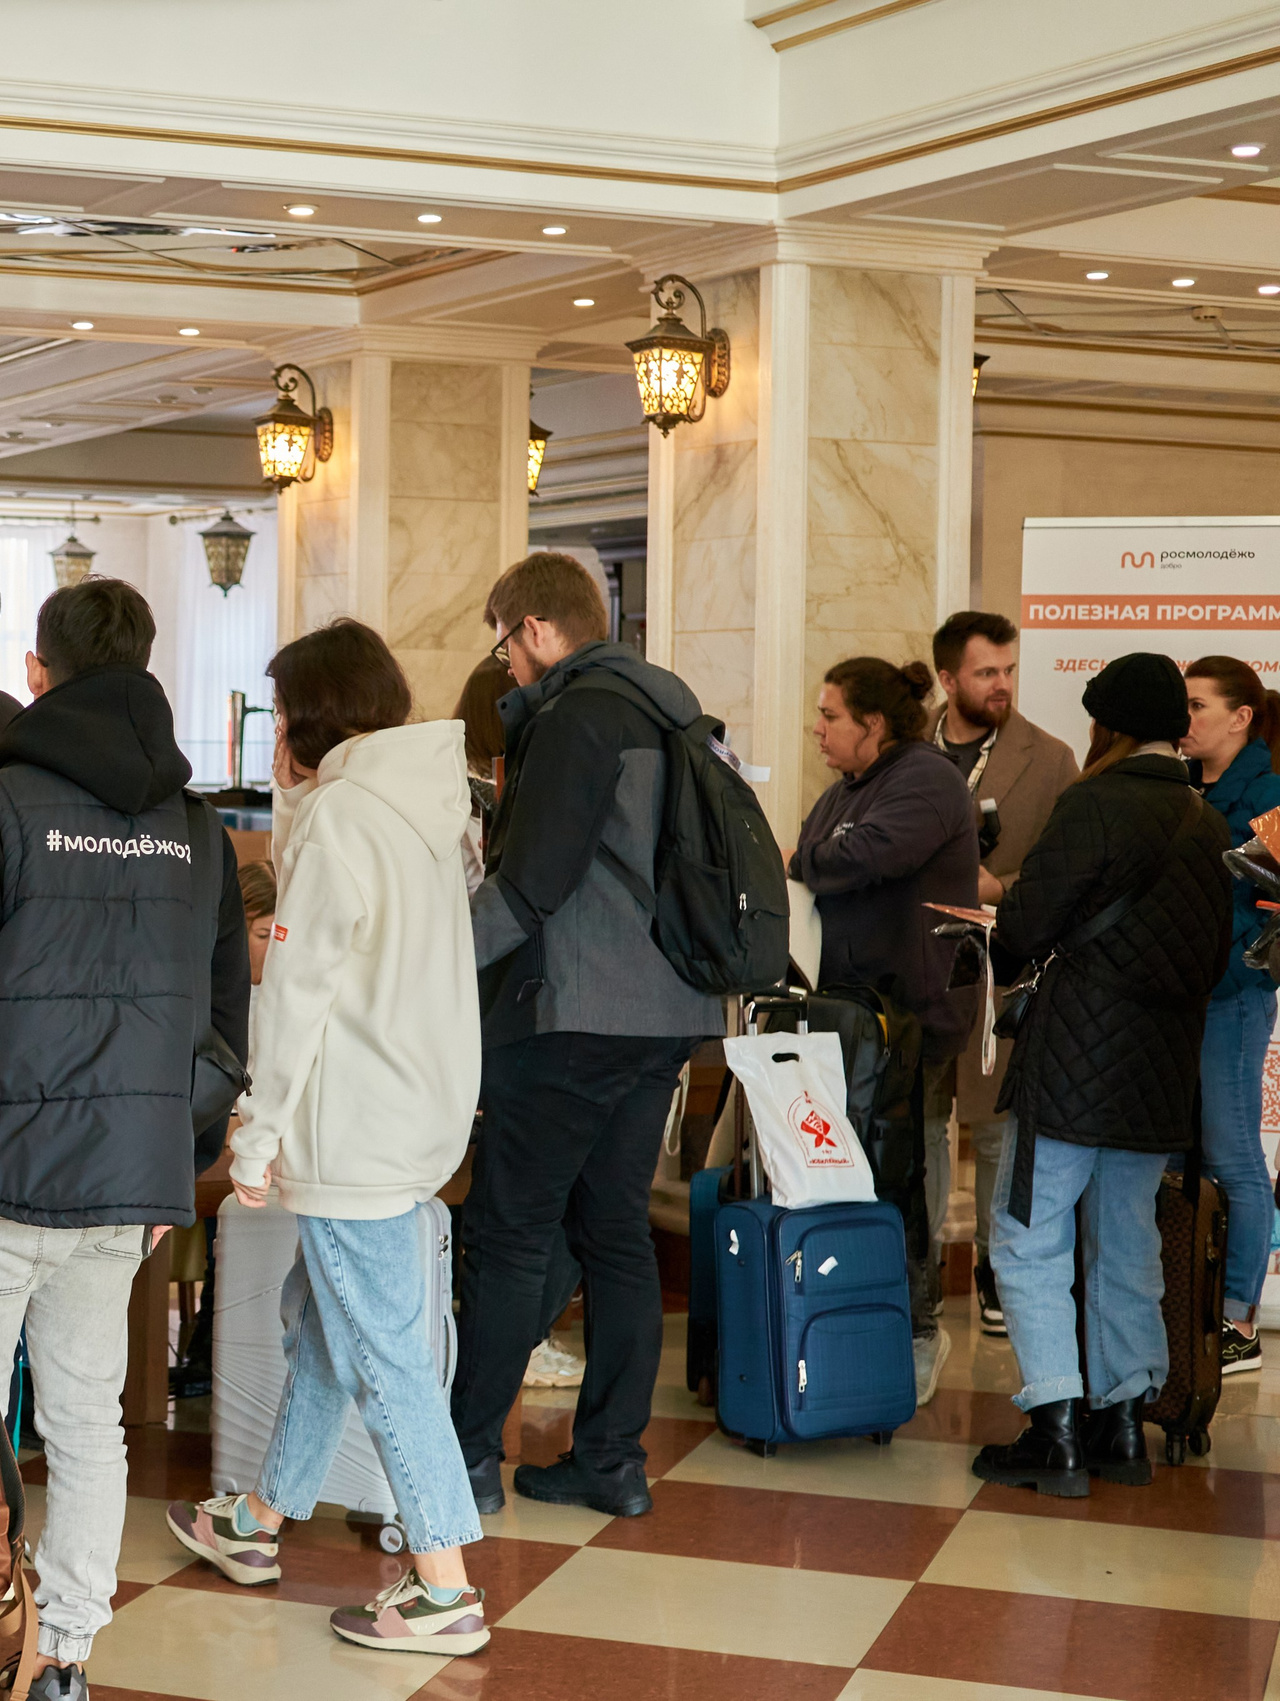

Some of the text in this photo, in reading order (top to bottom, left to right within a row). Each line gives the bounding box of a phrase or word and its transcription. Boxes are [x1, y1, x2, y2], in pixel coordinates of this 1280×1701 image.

[1160, 549, 1255, 562] росмолодёжь
[1029, 604, 1280, 621] ПОЛЕЗНАЯ ПРОГРАММ
[1054, 659, 1108, 672] ЗДЕСЬ
